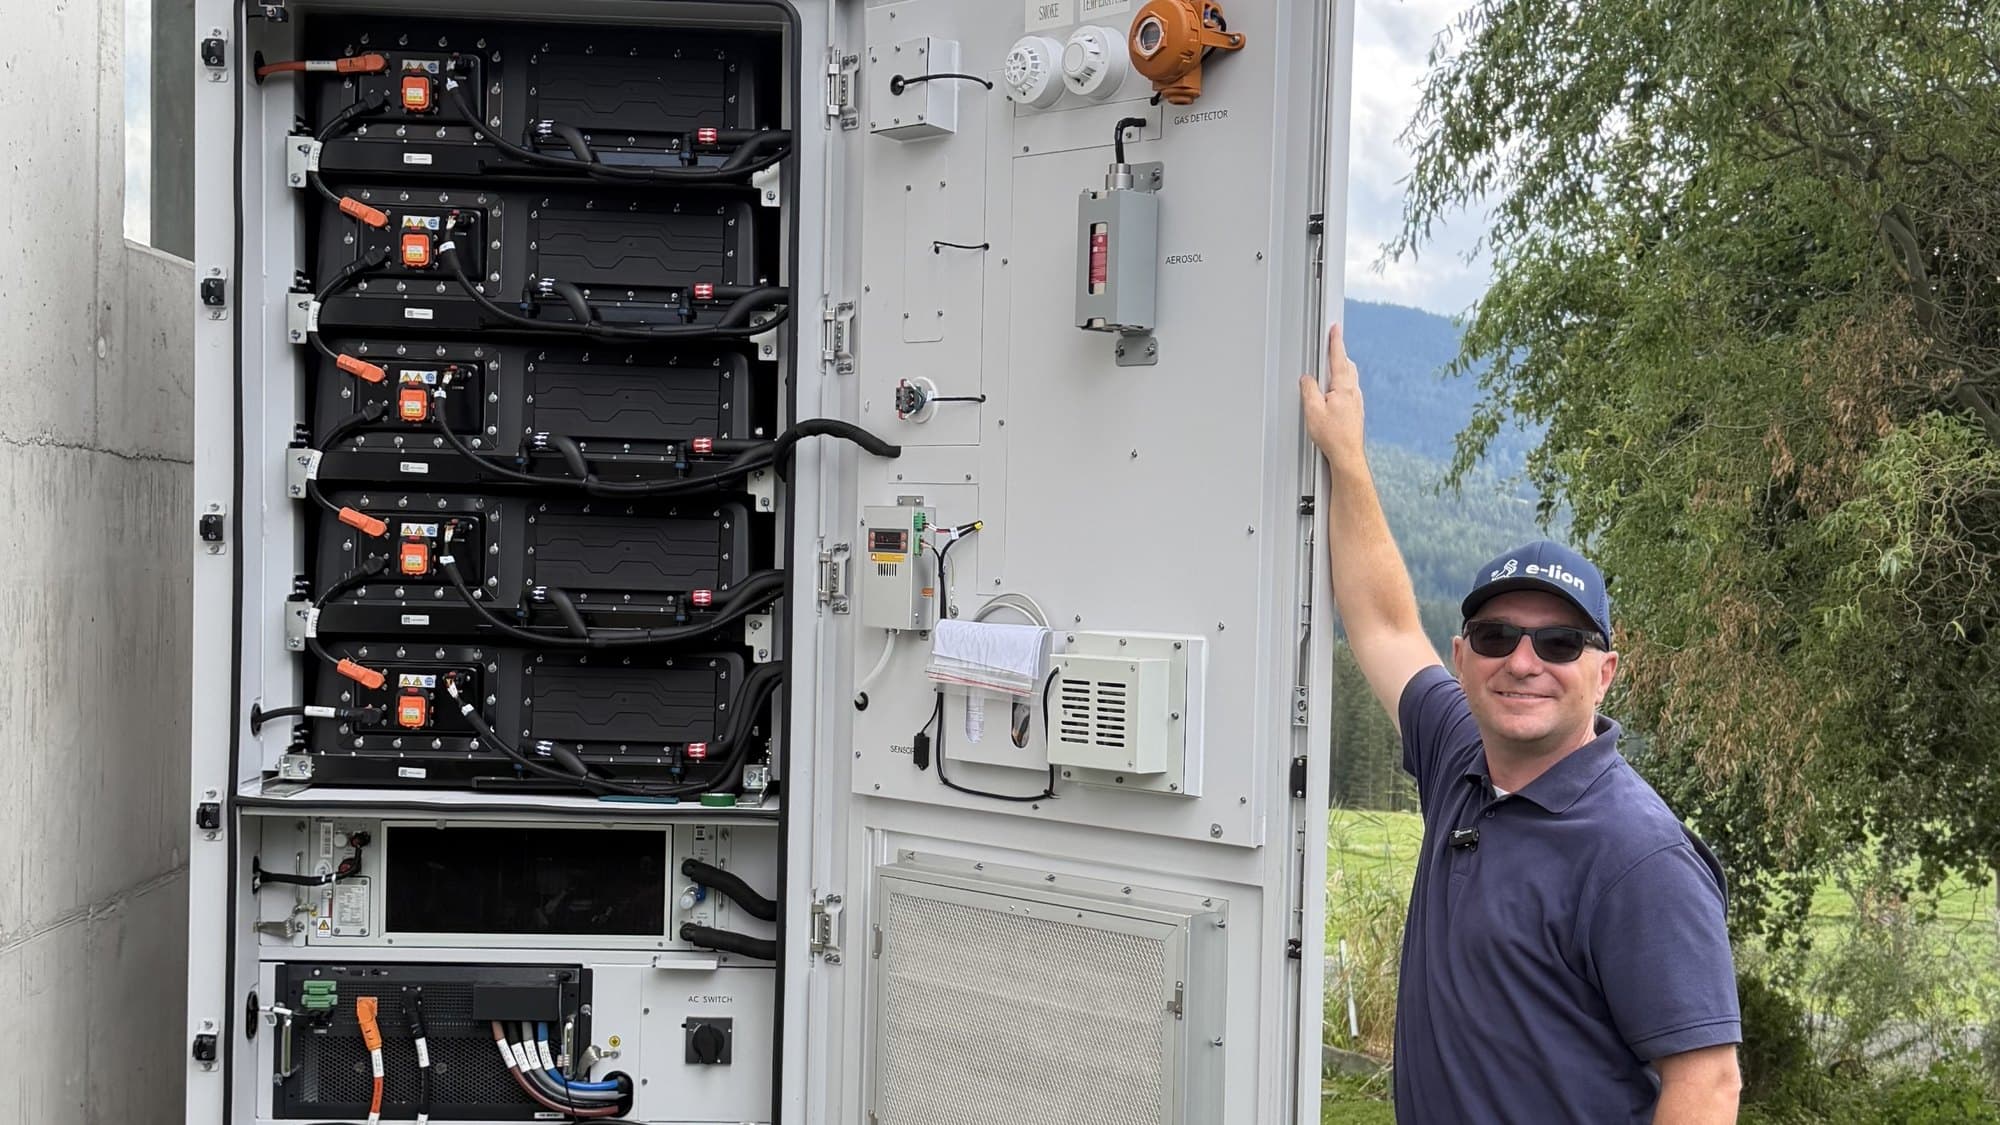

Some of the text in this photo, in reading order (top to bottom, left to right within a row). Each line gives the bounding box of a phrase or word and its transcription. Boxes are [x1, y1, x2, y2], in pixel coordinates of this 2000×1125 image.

[1039, 3, 1059, 20] SMOKE
[1174, 110, 1228, 125] GAS DETECTOR
[1165, 254, 1203, 264] AEROSOL
[1525, 564, 1585, 591] e-lion
[688, 995, 733, 1003] AC SWITCH
